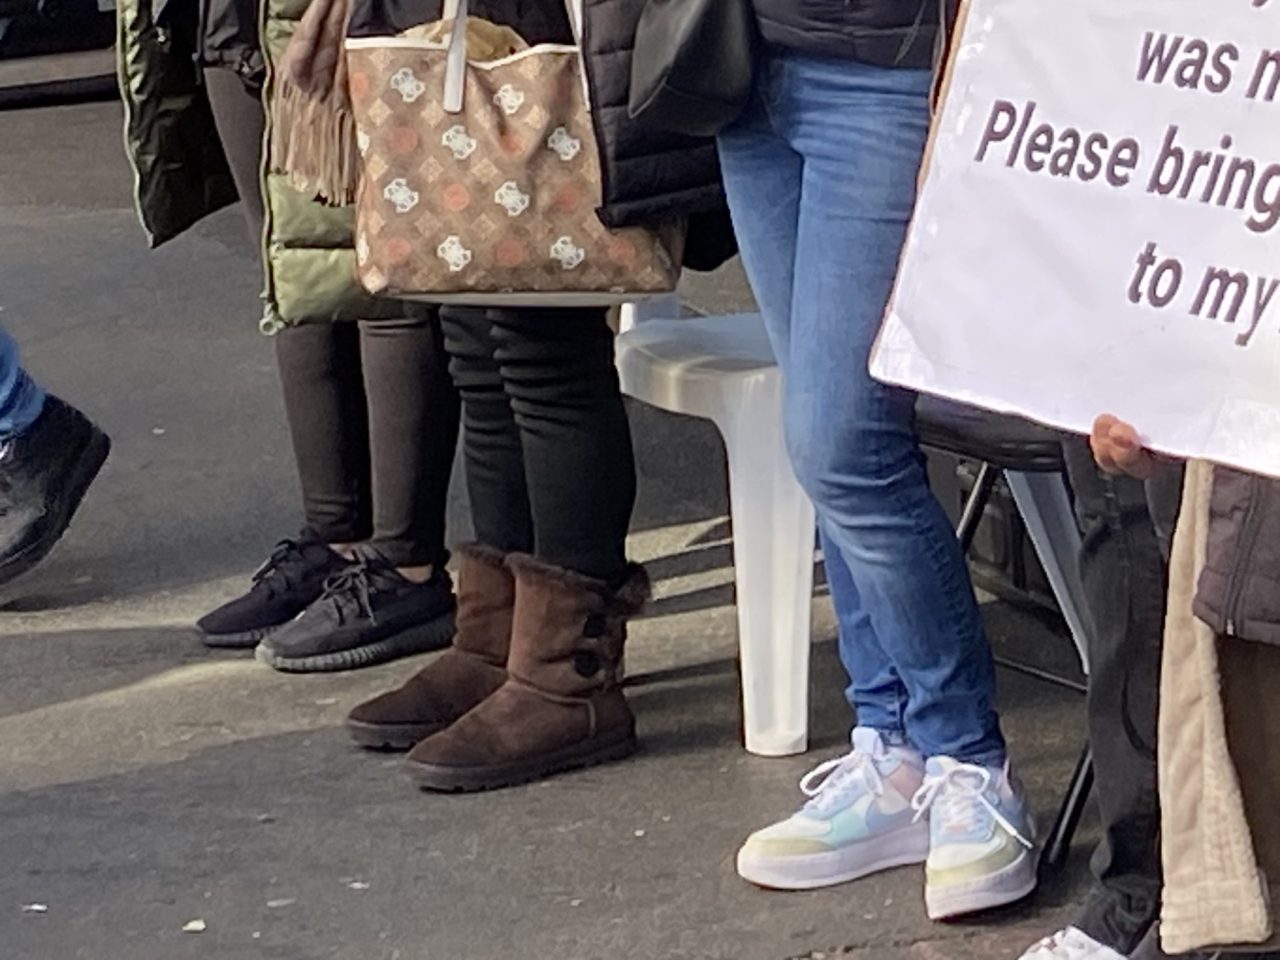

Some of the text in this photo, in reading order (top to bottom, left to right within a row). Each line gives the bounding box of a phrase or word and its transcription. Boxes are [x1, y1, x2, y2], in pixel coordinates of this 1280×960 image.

[1135, 30, 1238, 94] was
[974, 98, 1140, 187] Please
[1126, 241, 1182, 308] to
[1189, 263, 1280, 347] my
